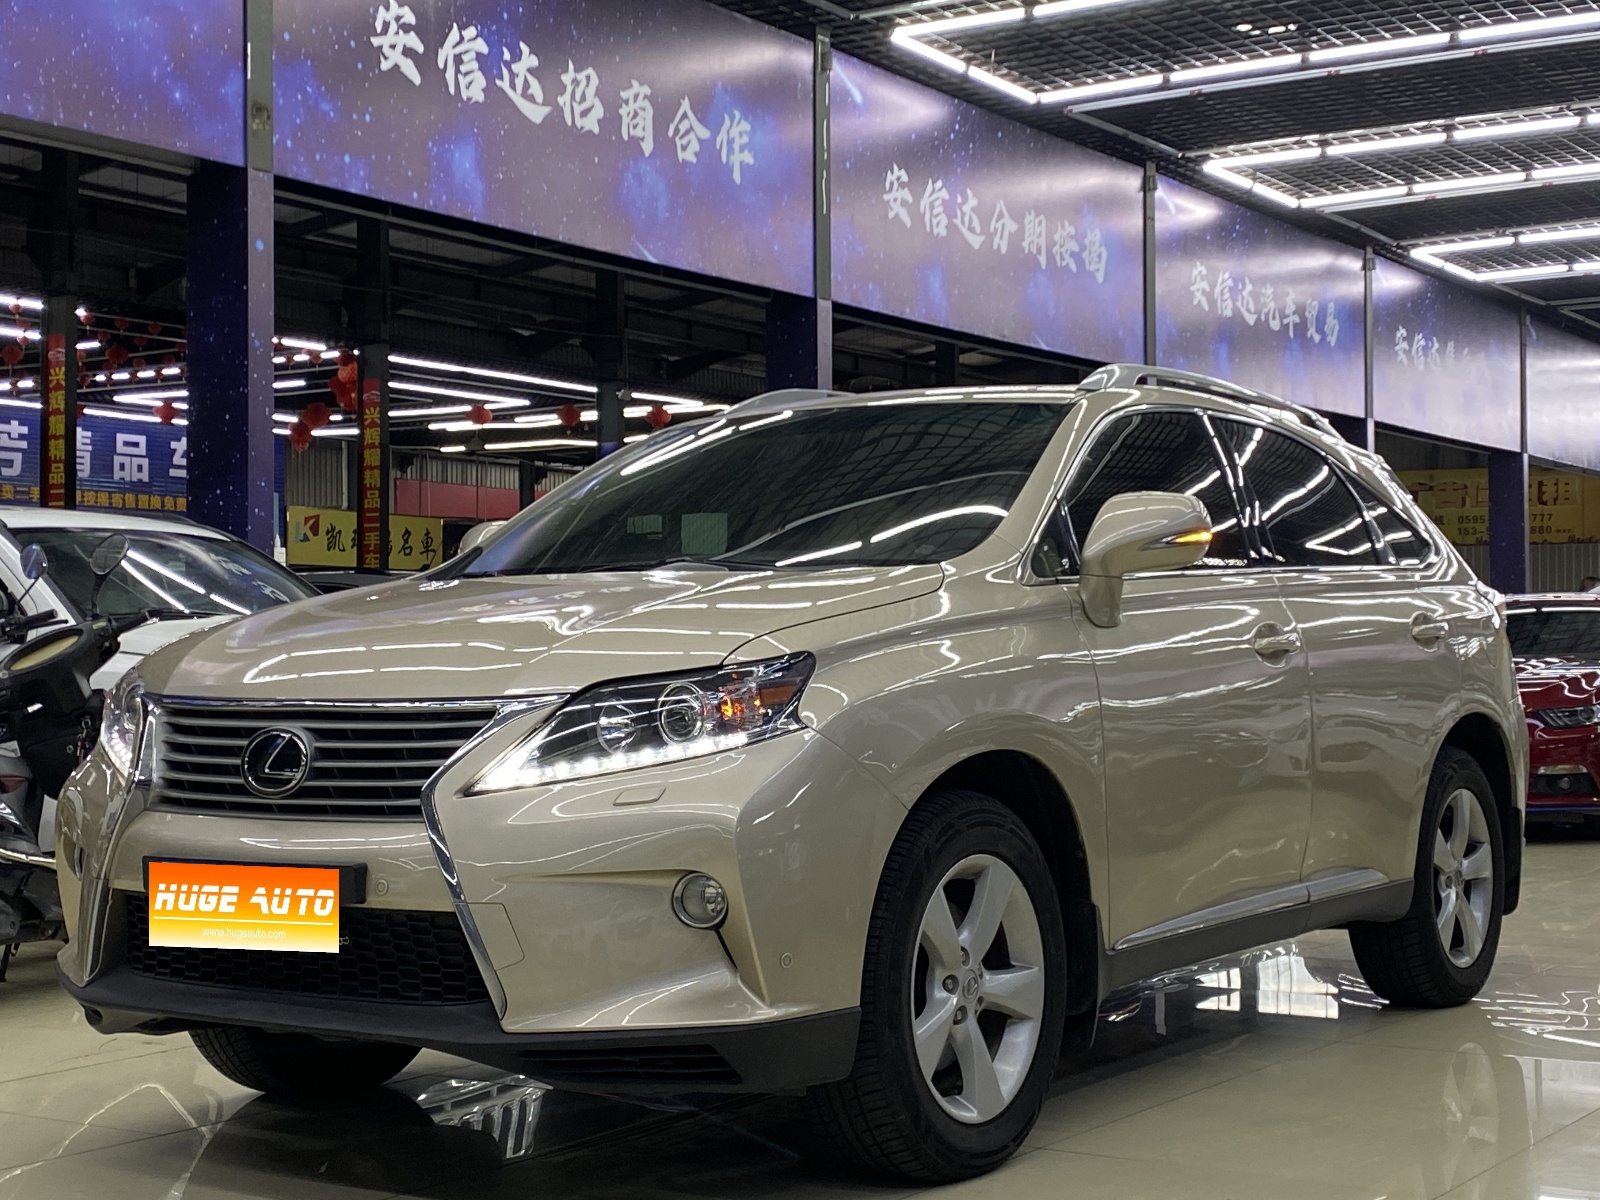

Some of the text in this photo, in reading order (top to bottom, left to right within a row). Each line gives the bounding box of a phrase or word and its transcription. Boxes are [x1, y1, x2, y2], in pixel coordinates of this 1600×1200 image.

[370, 0, 754, 185] 安信达招商合作
[883, 162, 1108, 284] 安信达分期按揭
[1190, 261, 1339, 347] 安信达汽车贸易
